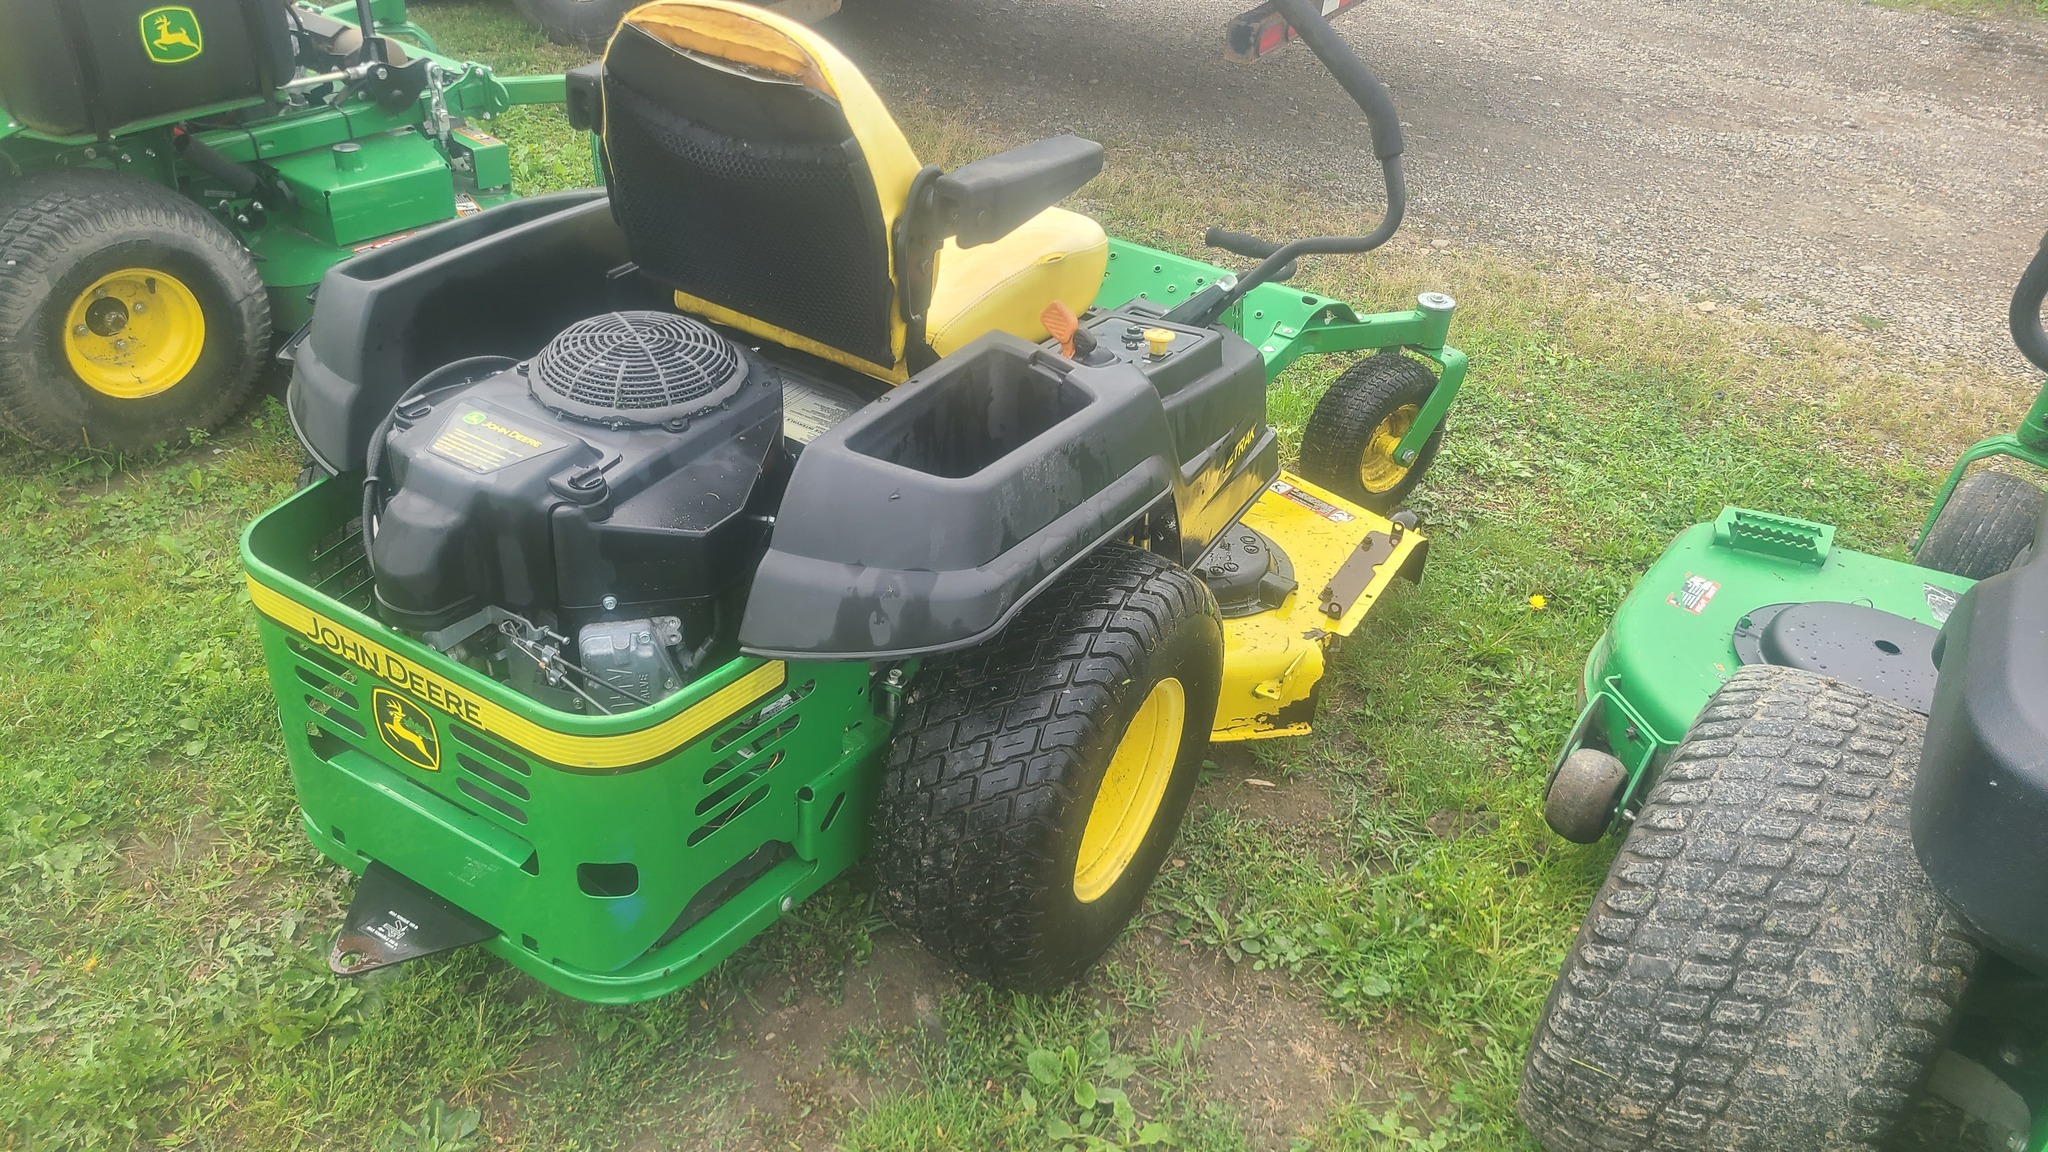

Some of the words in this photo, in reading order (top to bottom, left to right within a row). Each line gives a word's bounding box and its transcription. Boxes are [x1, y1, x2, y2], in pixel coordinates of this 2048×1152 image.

[481, 421, 510, 437] JOHN
[508, 431, 543, 448] DEERE
[306, 617, 391, 674] JOHN
[385, 655, 484, 727] DEERE
